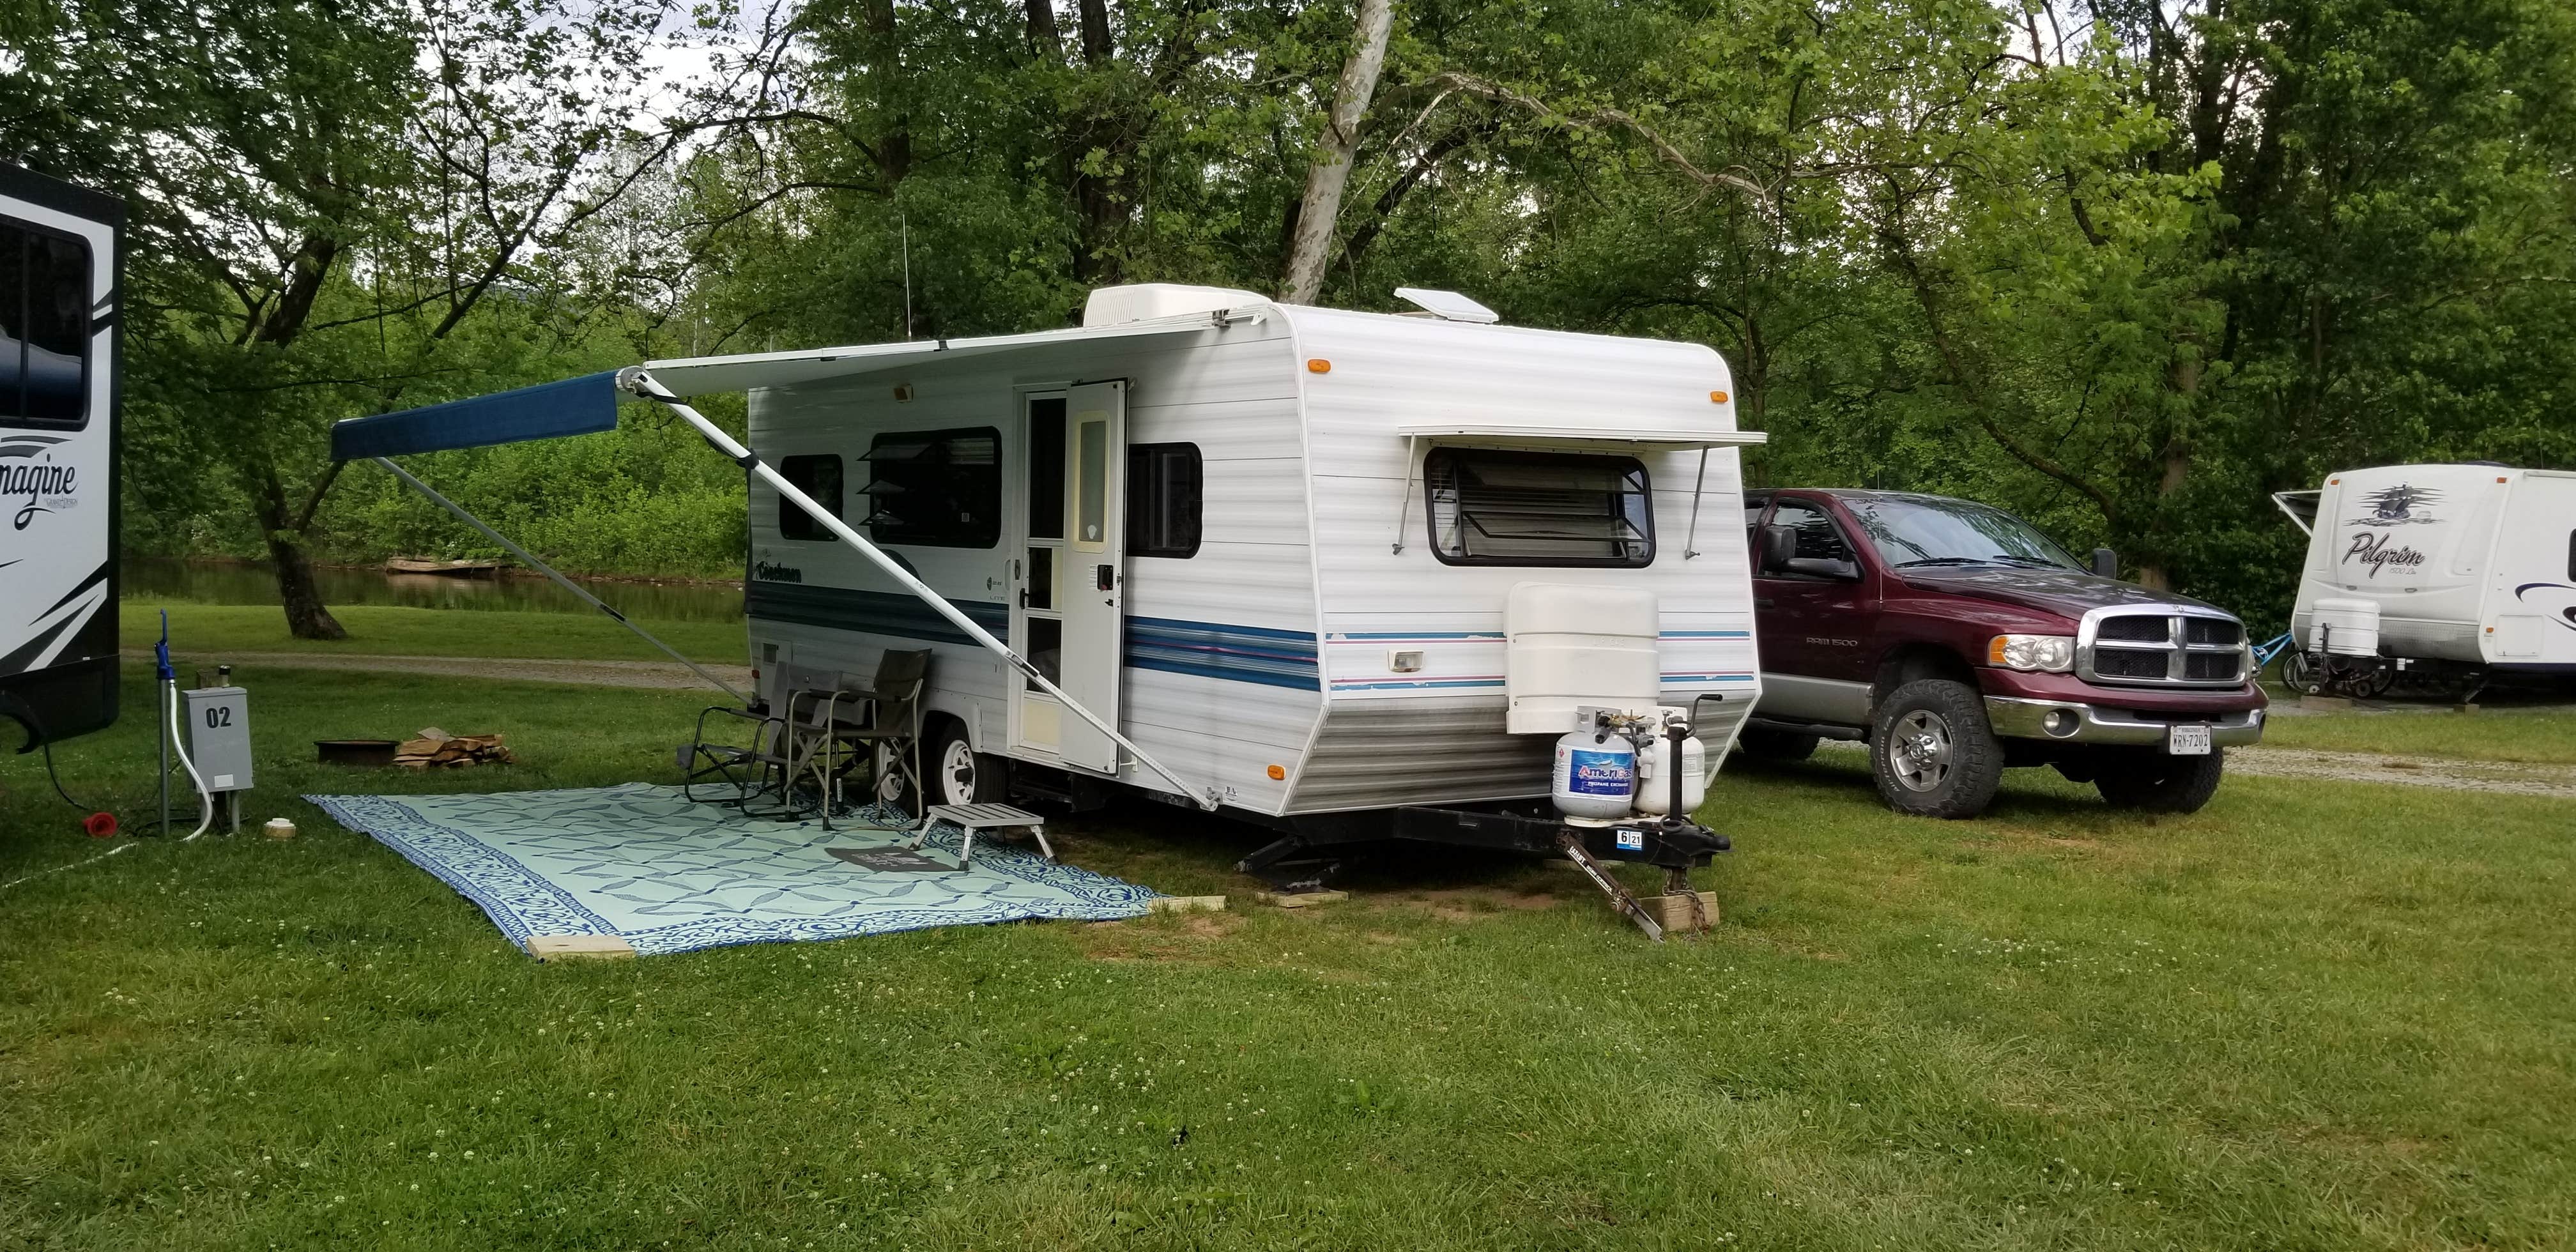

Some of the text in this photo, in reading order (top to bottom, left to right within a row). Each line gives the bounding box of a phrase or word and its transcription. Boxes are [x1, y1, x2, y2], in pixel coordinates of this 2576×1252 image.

[0, 453, 78, 531] magine
[2342, 531, 2426, 579] Pilgrim
[206, 706, 231, 728] 02
[1621, 832, 1627, 843] 6
